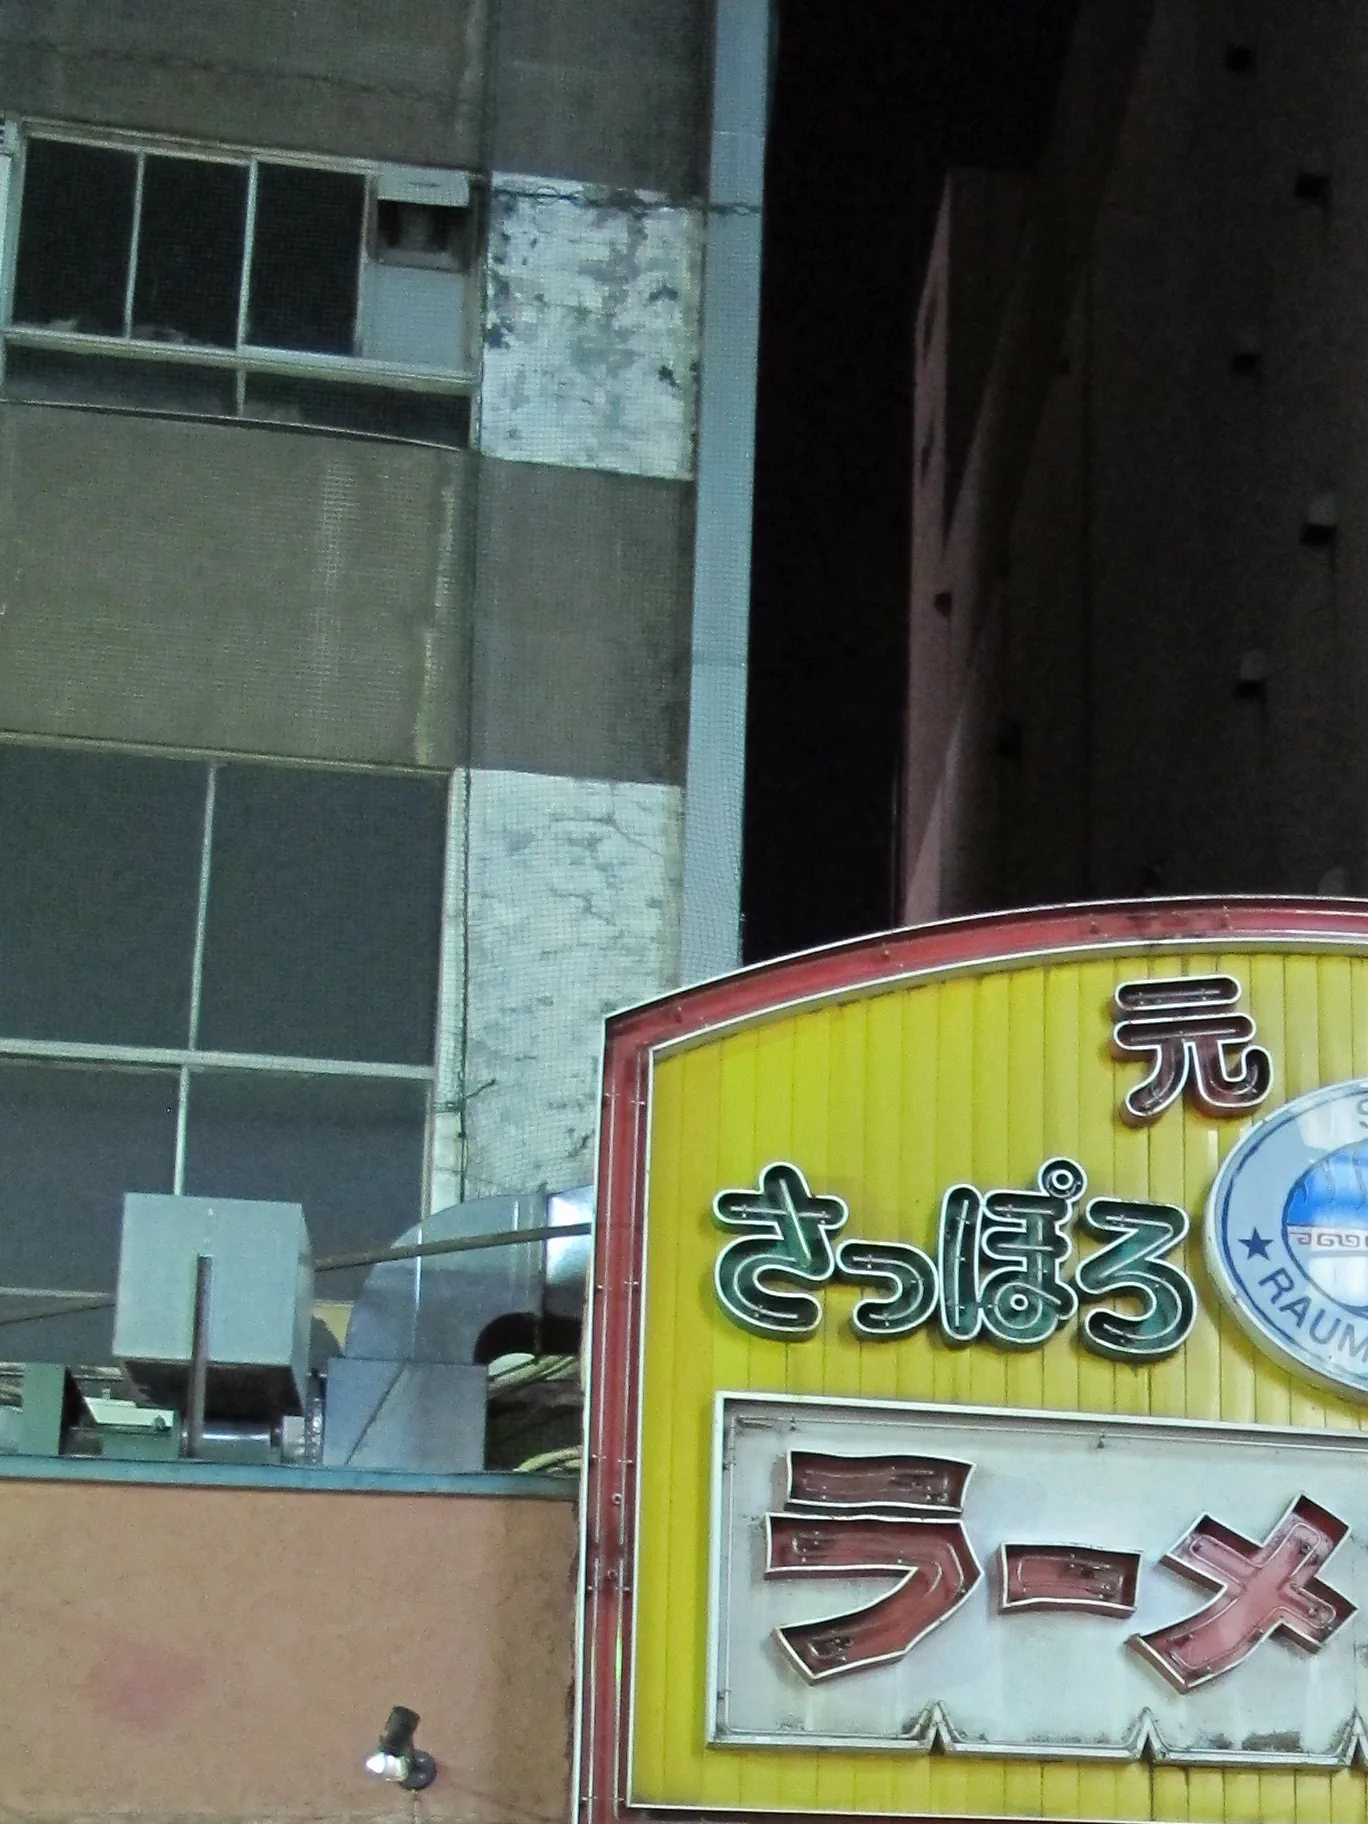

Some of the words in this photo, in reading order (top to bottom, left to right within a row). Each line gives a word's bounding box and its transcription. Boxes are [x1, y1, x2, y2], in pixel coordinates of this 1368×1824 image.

[1113, 976, 1271, 1127] 元
[712, 1156, 1197, 1362] さっぽろ
